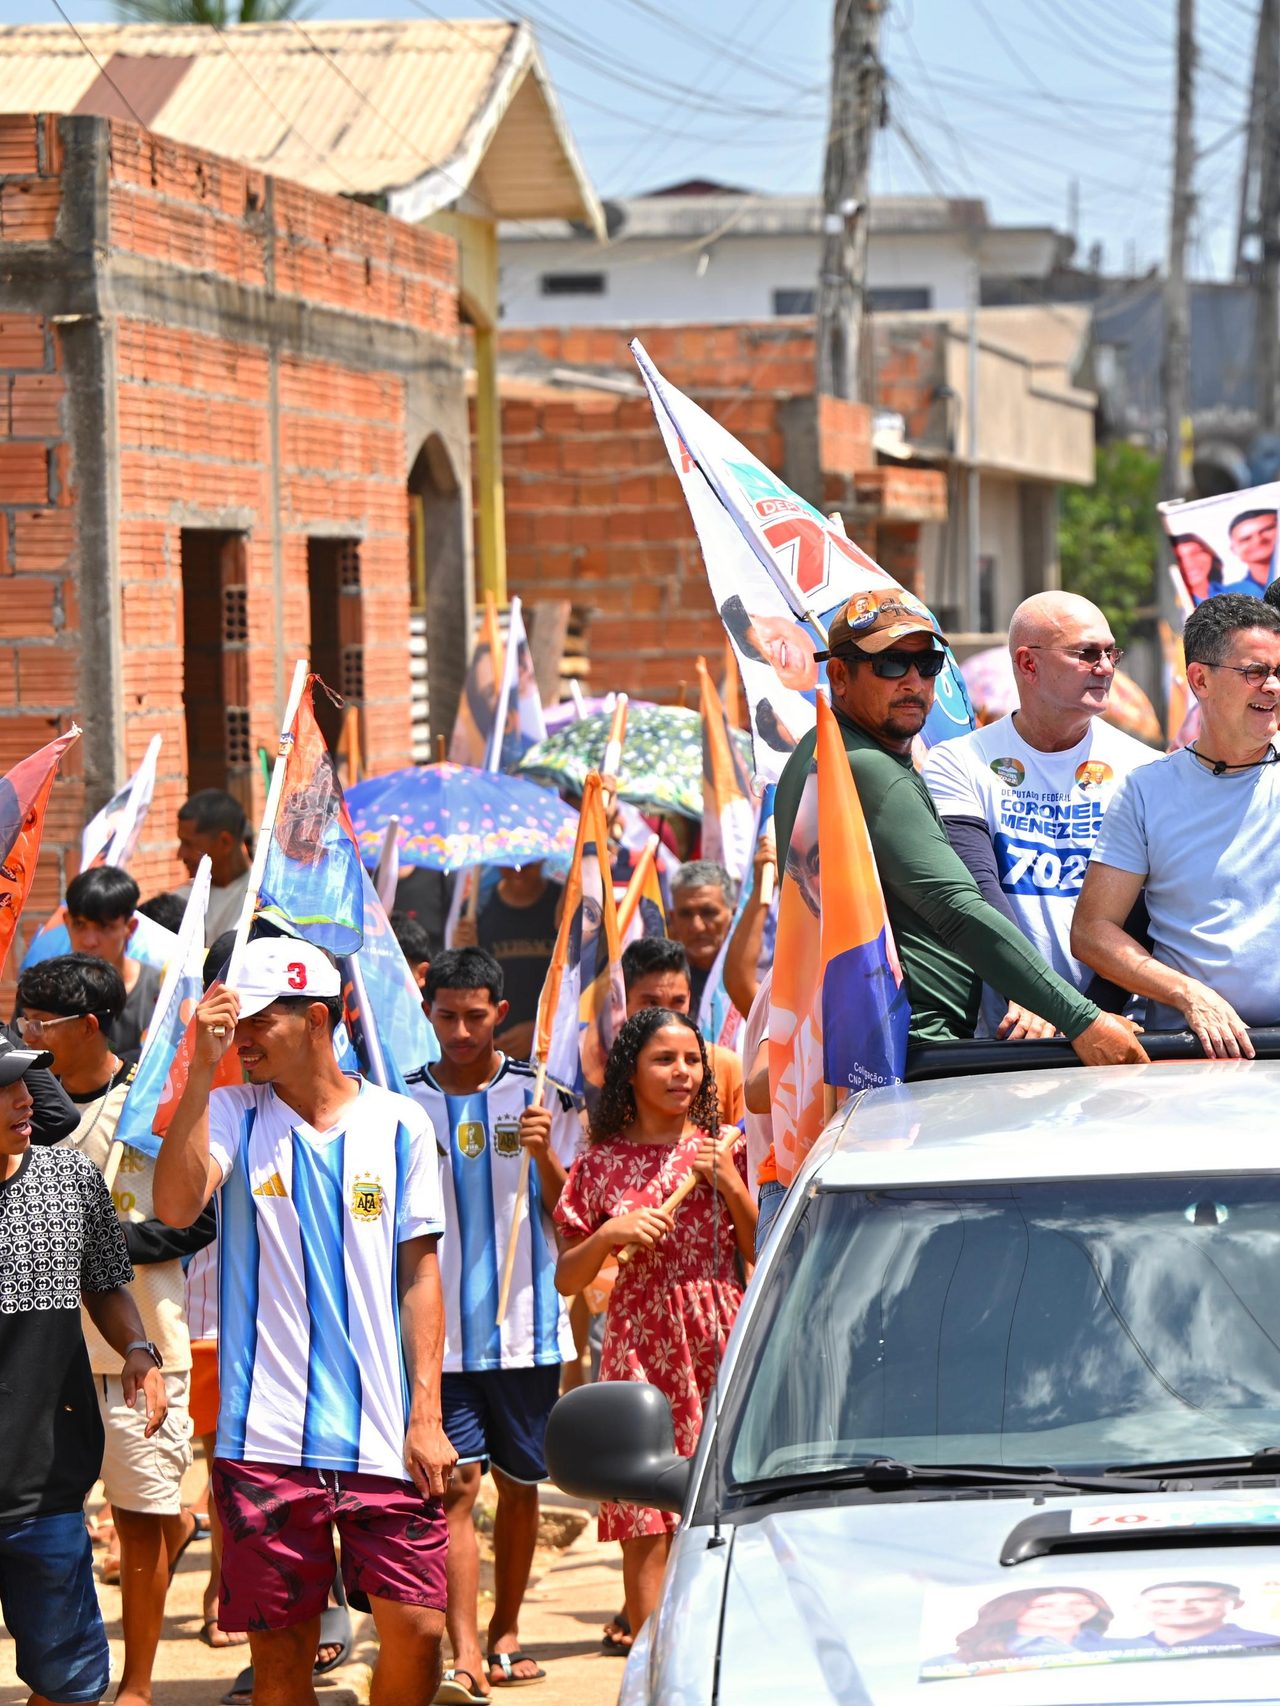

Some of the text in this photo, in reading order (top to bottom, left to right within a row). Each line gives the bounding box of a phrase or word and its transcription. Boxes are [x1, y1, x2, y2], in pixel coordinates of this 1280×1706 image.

[1001, 789, 1071, 802] DEPUTADO FEDERAL
[1001, 799, 1105, 820] CORONEL
[287, 962, 307, 990] 3
[357, 1192, 376, 1212] AFA
